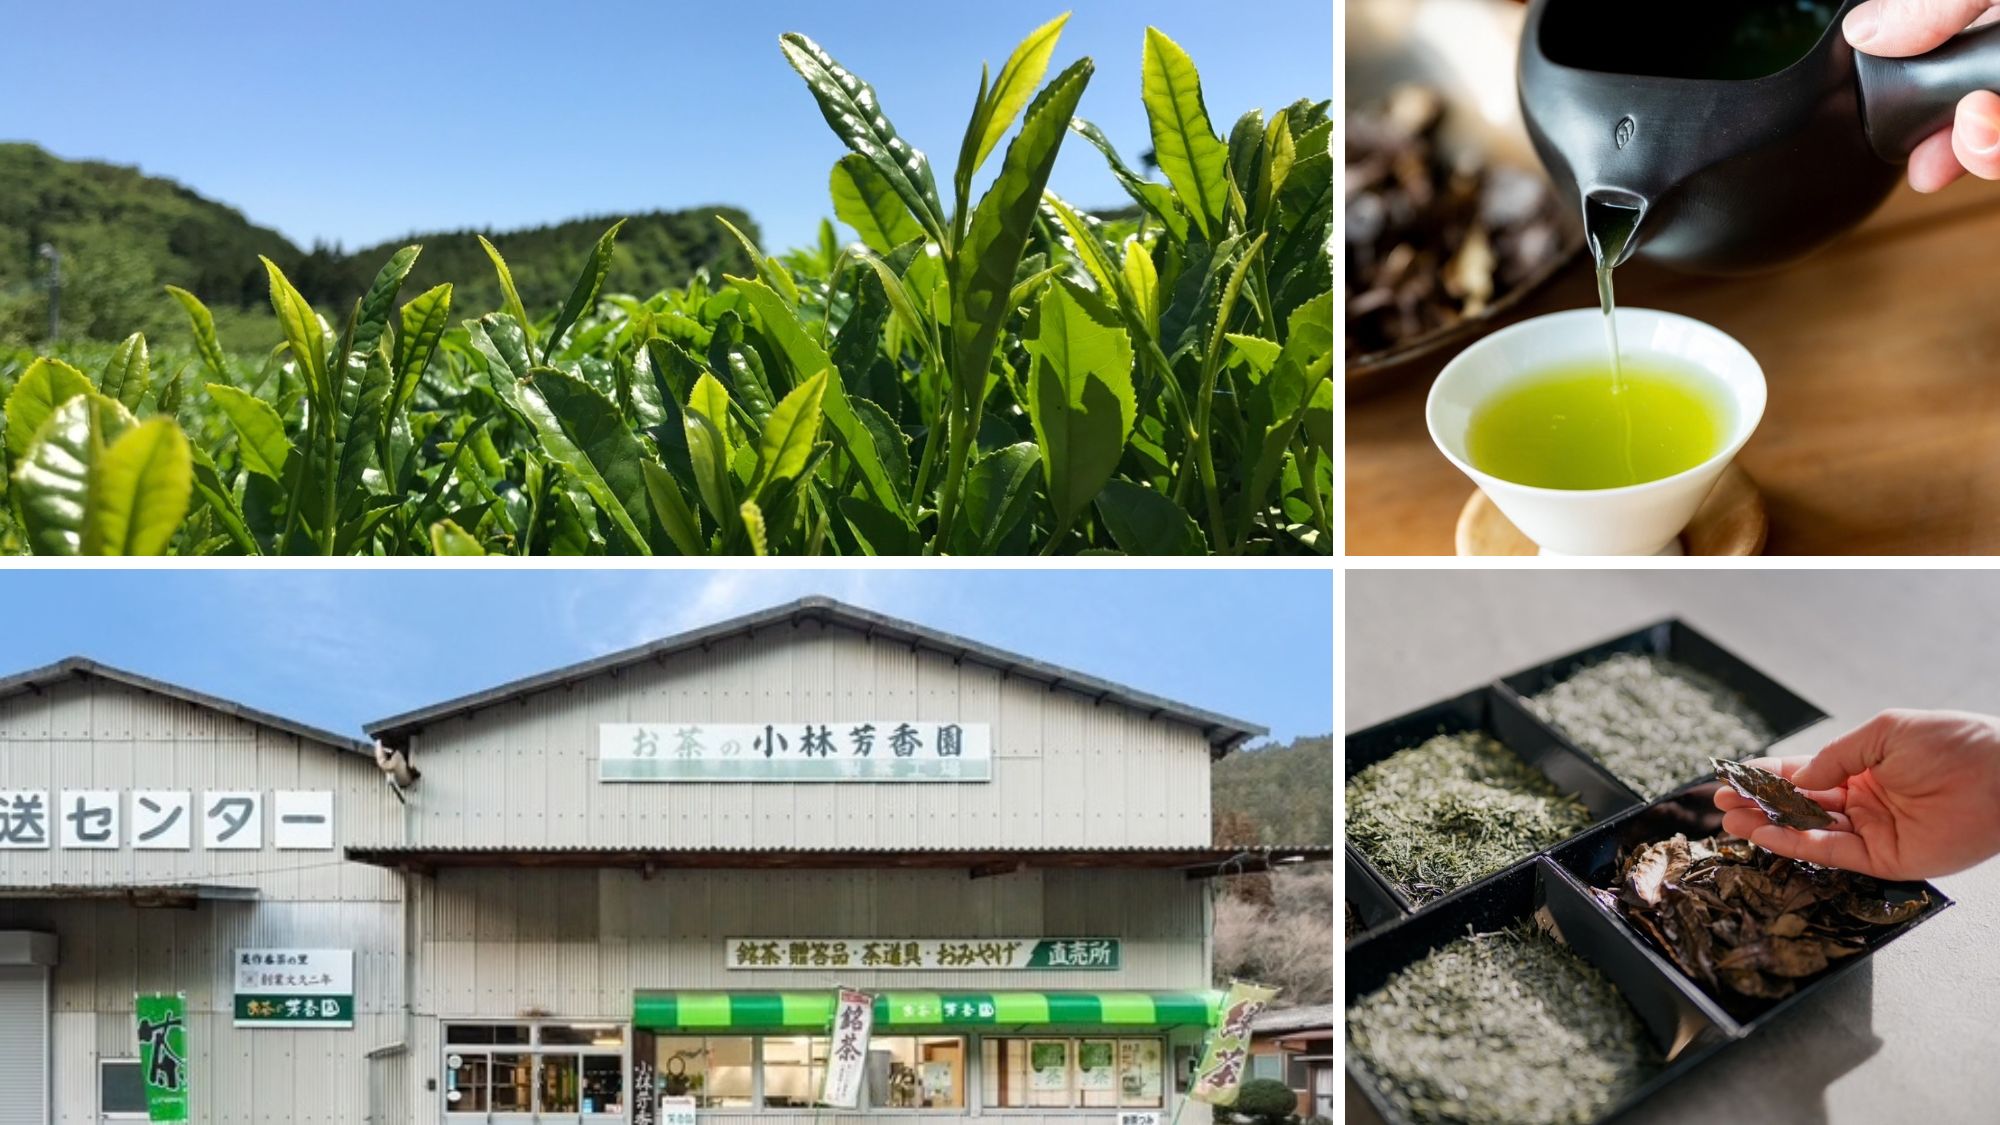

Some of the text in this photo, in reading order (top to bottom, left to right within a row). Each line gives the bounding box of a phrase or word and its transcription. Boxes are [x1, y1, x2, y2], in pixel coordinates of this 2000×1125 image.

[631, 722, 964, 758] お茶の小林芳香園
[0, 793, 326, 843] 送センター
[1047, 941, 1111, 966] 直売所
[834, 1005, 864, 1062] 銘茶
